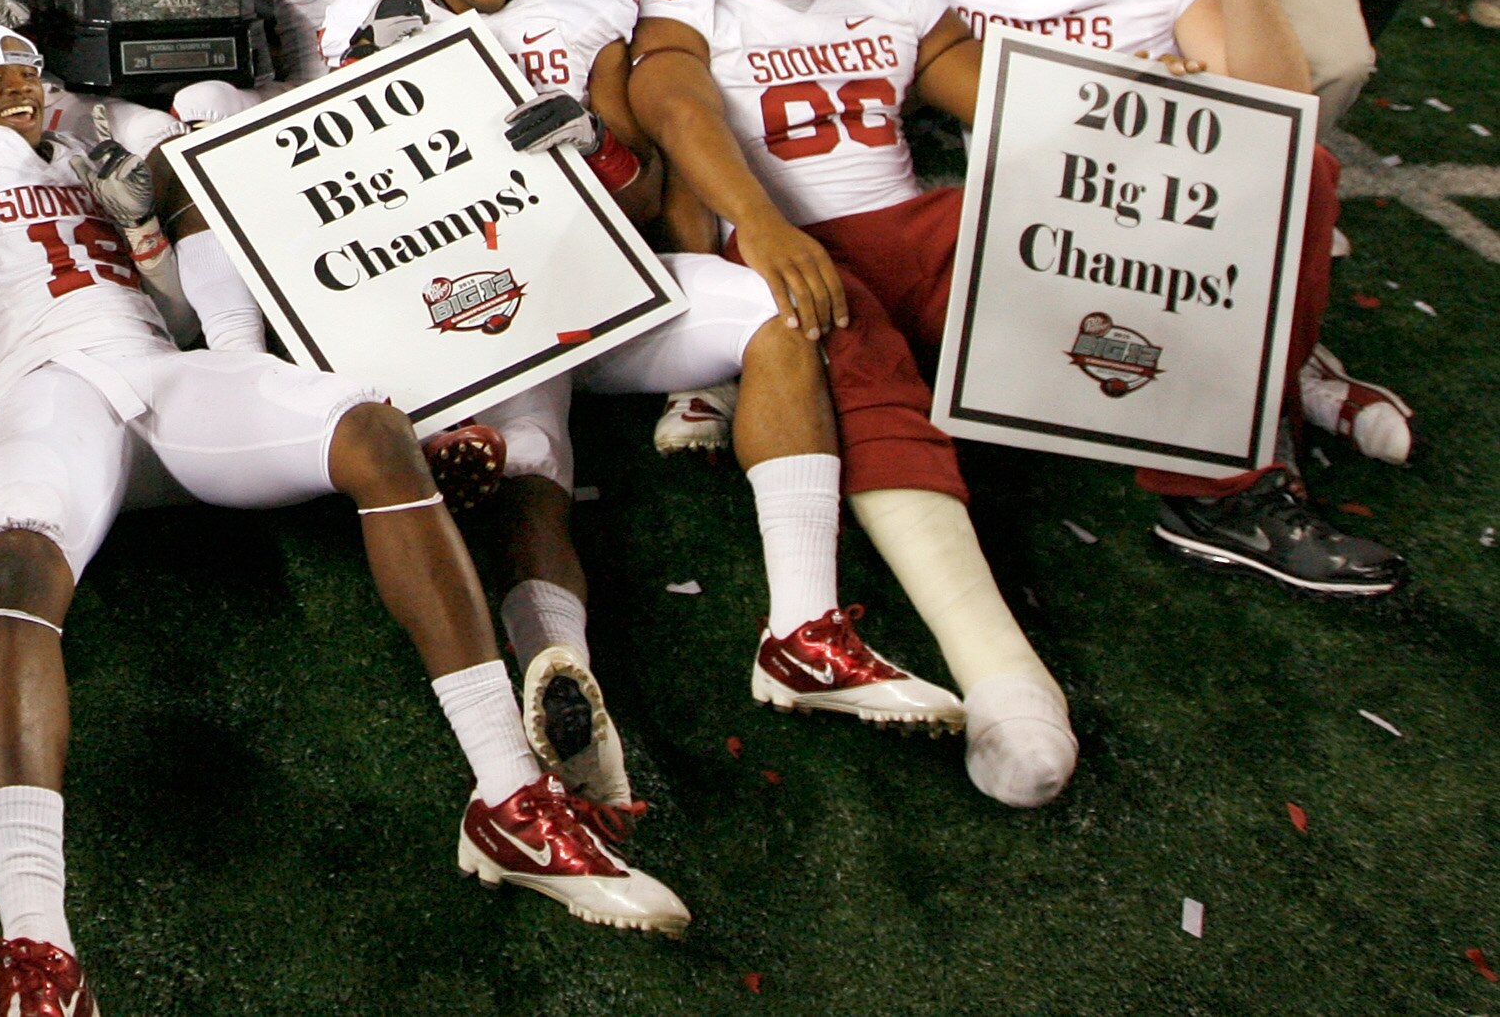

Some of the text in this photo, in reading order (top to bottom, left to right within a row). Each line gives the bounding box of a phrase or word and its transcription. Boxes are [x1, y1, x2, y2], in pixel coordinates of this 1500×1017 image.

[748, 34, 898, 84] SOONERS
[275, 79, 425, 169] 2010
[1074, 82, 1222, 155] 2010
[297, 128, 474, 228] Big 12
[1056, 151, 1220, 230] Big 12
[27, 220, 140, 299] 19
[313, 169, 540, 291] Champs!
[1018, 223, 1239, 314] Champs!
[431, 285, 481, 323] BIG
[480, 270, 515, 300] 12
